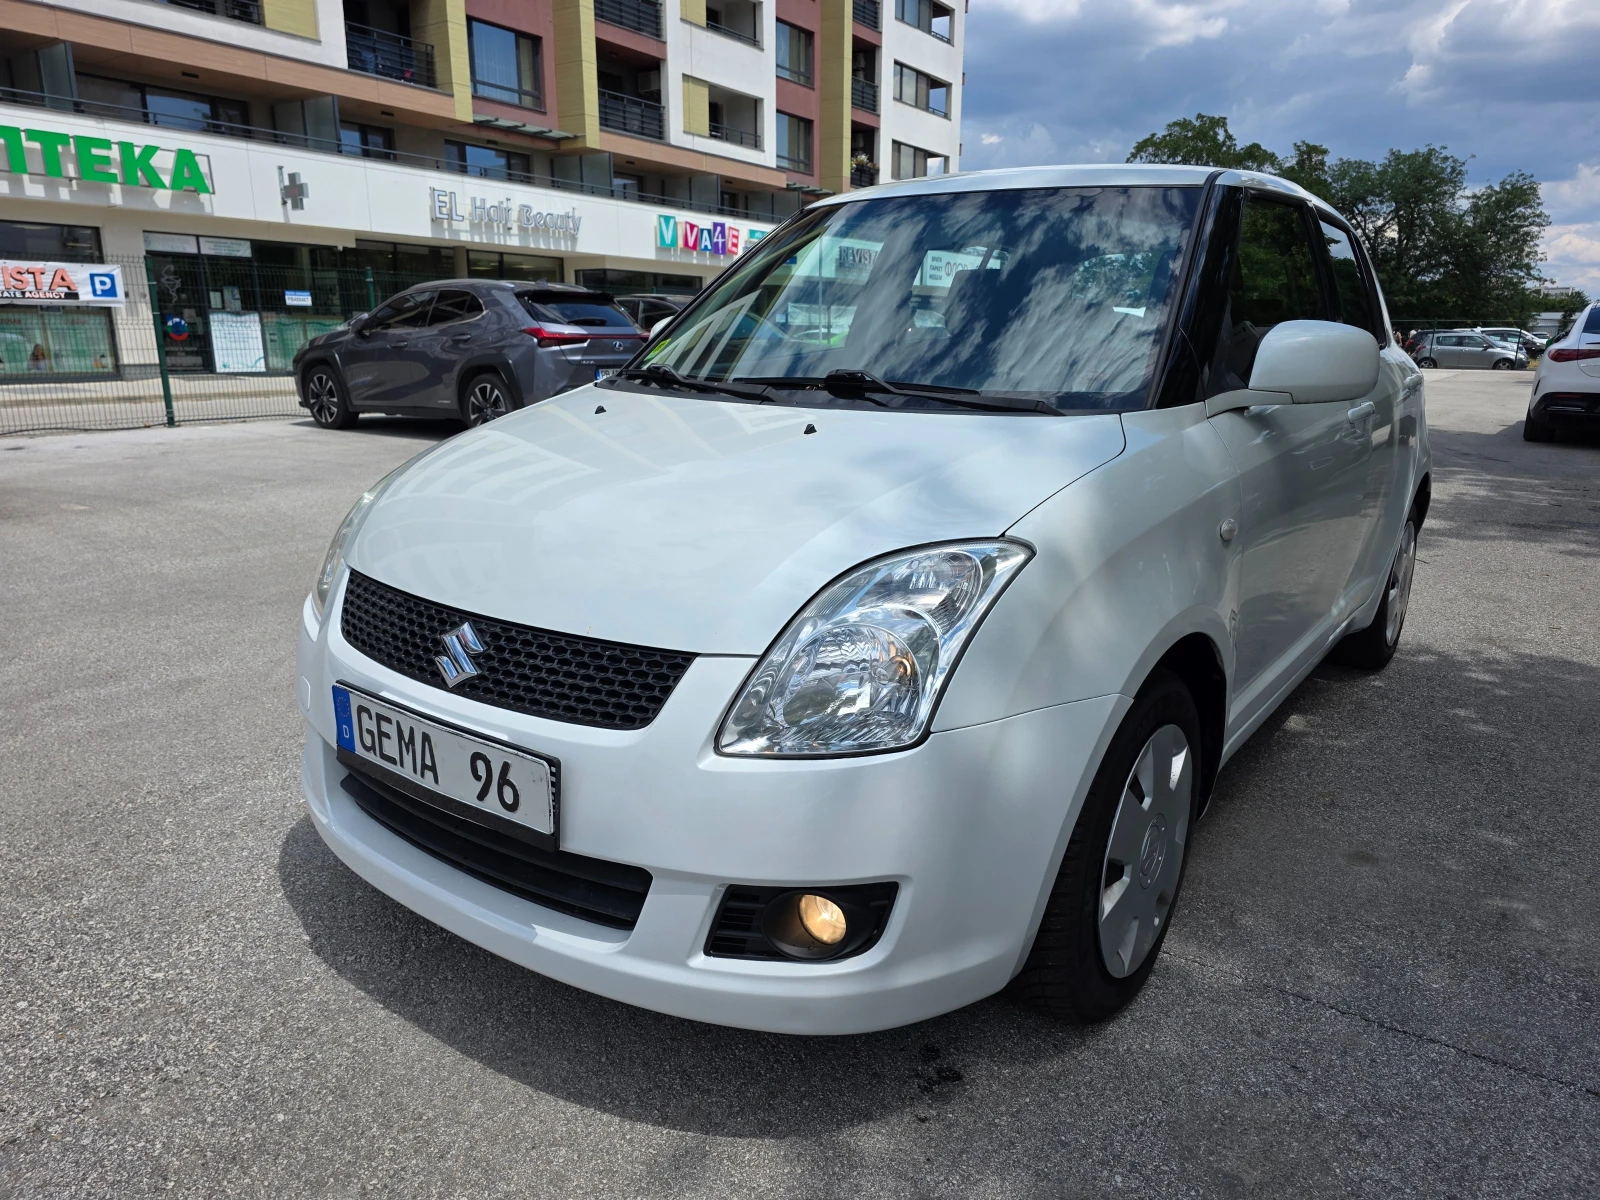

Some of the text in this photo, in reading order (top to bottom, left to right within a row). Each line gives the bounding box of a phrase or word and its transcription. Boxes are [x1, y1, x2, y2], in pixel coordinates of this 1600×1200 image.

[433, 189, 582, 237] EL Hair Beauty
[1, 266, 78, 291] ISTA
[94, 276, 112, 295] P
[25, 291, 66, 299] AGENCY
[342, 704, 520, 813] D GEMA 96
